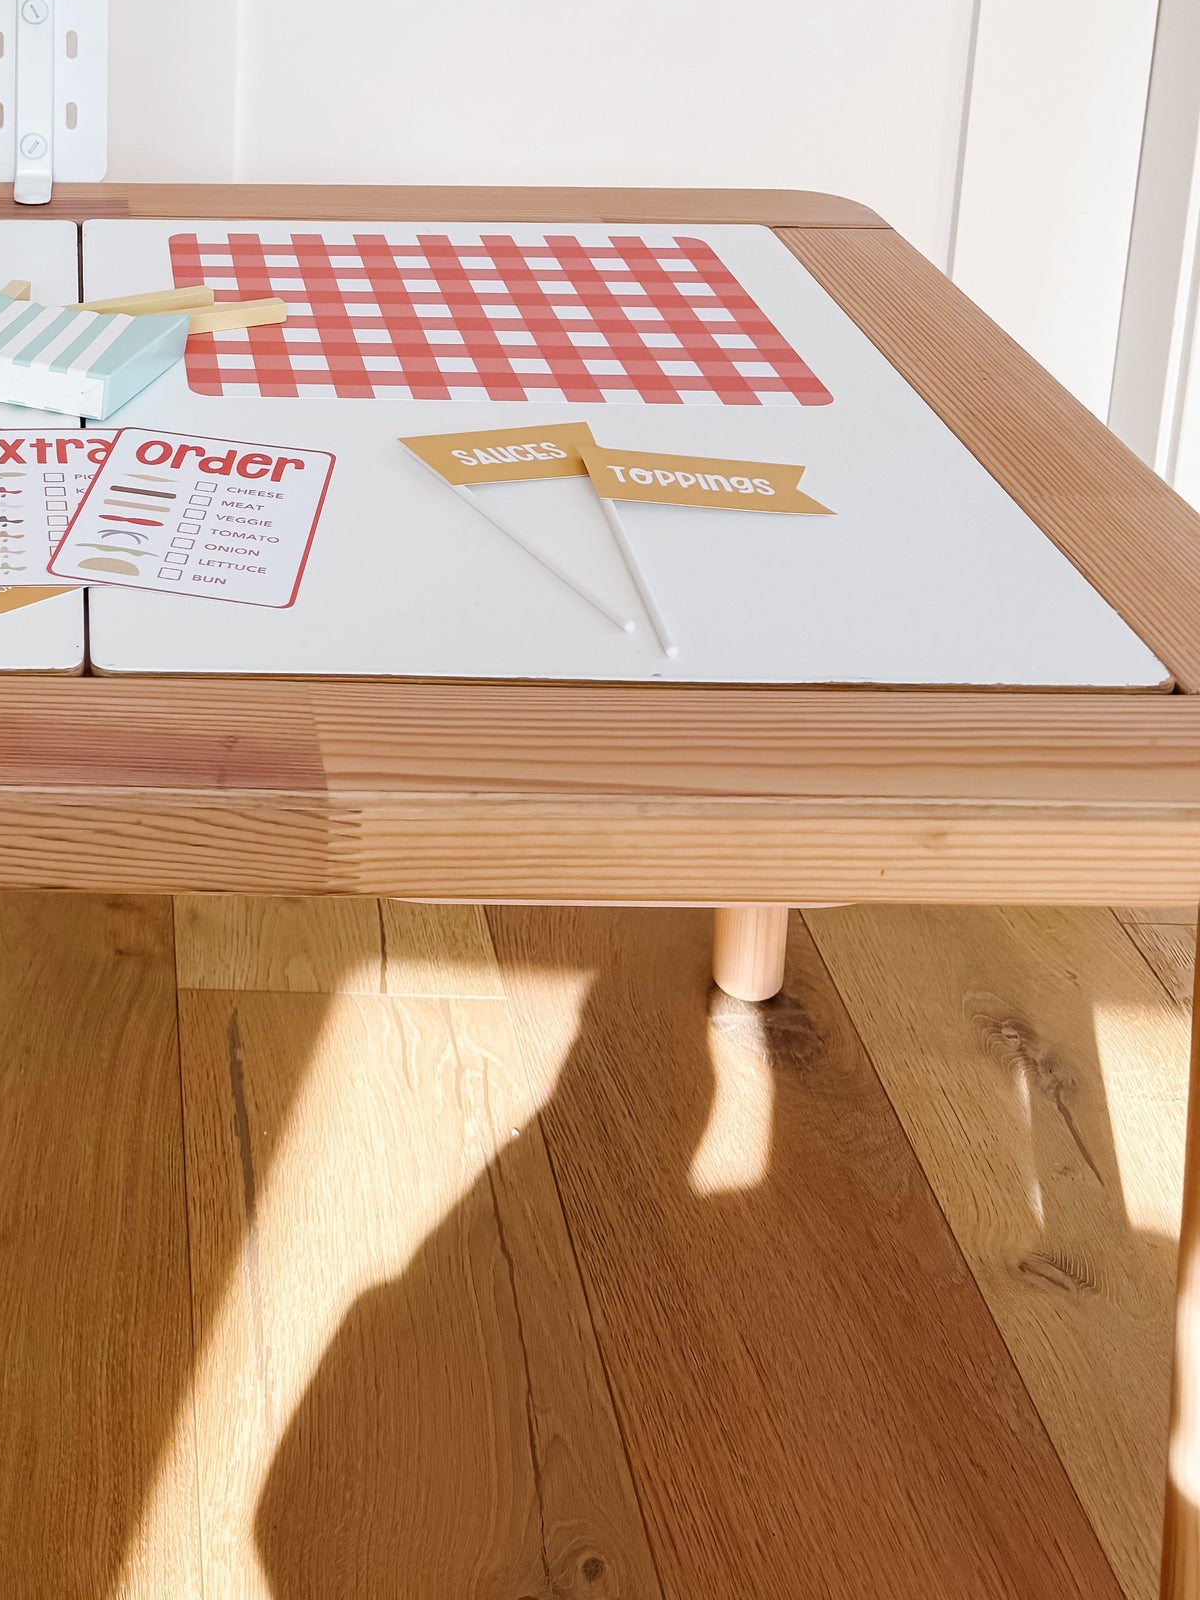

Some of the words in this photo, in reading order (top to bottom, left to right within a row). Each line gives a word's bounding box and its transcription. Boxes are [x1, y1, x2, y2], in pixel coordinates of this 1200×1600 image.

[135, 440, 305, 483] order
[226, 486, 285, 500] CHEESE
[221, 500, 265, 511] MEAT
[216, 514, 273, 527] VEGGIE
[210, 528, 280, 544] TOMATO
[204, 544, 261, 557] ONION
[198, 558, 268, 575] LETTUCE
[191, 574, 227, 585] BUN
